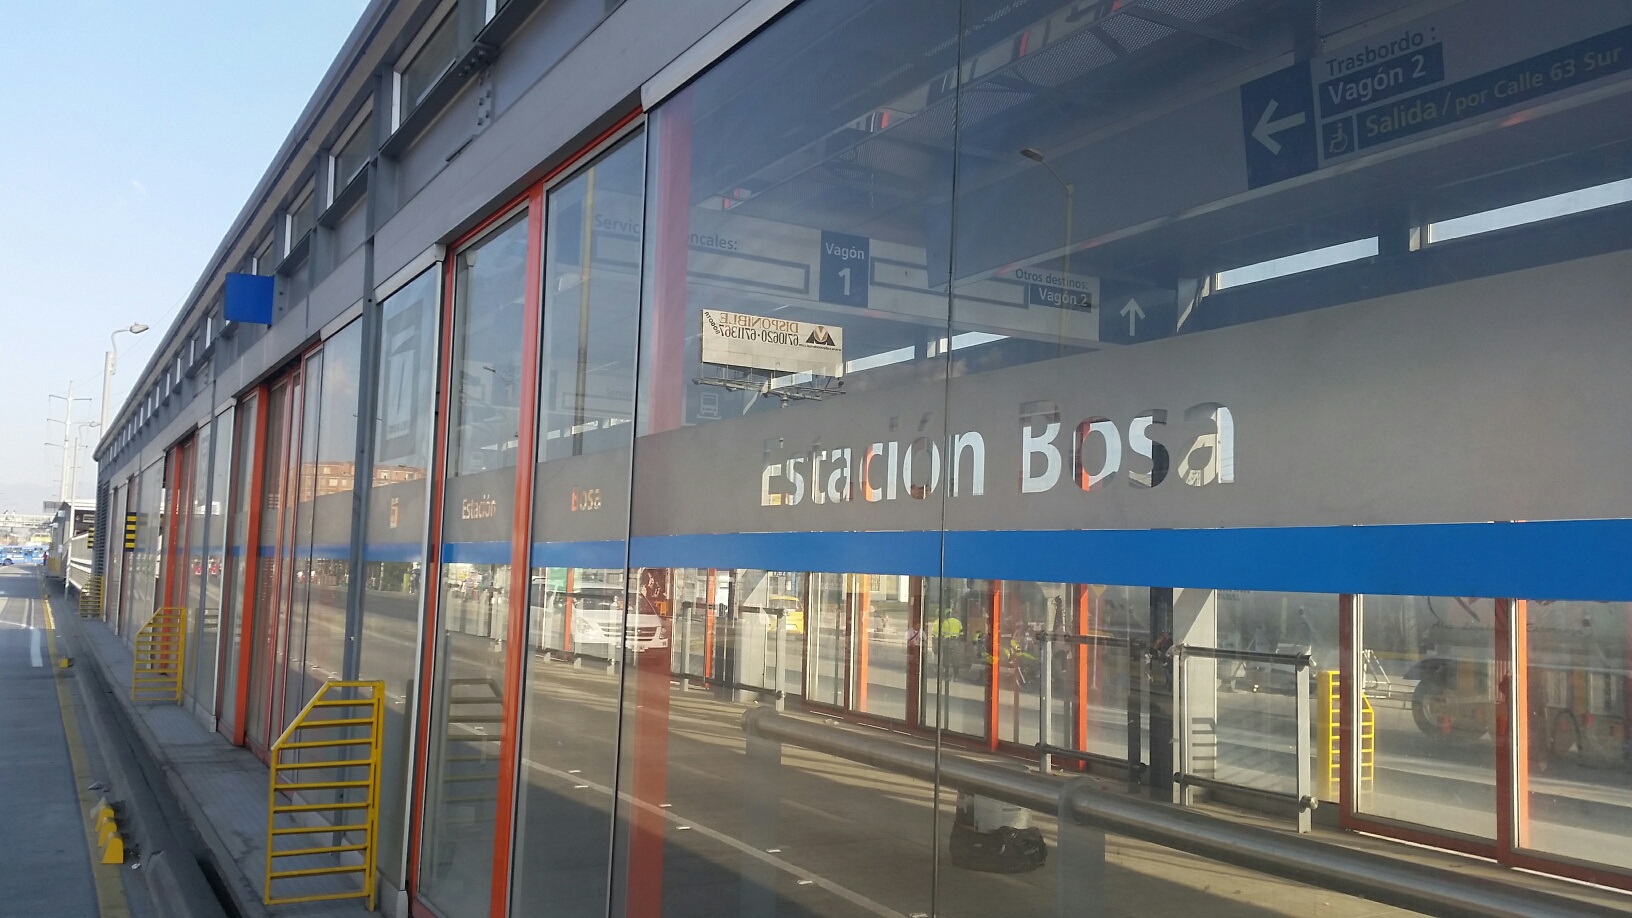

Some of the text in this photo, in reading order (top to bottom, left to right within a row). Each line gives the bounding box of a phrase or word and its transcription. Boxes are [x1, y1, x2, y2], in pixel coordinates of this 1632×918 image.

[1328, 54, 1426, 105] Vagón 2
[1365, 99, 1437, 138] Salida
[1455, 88, 1488, 116] por
[1494, 71, 1544, 99] Calle
[1550, 61, 1576, 82] 63
[1583, 45, 1623, 72] Sur
[594, 213, 738, 251] Servic ncales:
[825, 242, 865, 261] Vagón
[838, 267, 851, 296] 1
[1015, 268, 1089, 290] Otros destinos:
[1039, 287, 1088, 307] Vagón 2
[760, 401, 1236, 507] Estación Bosa
[461, 494, 497, 520] Estación
